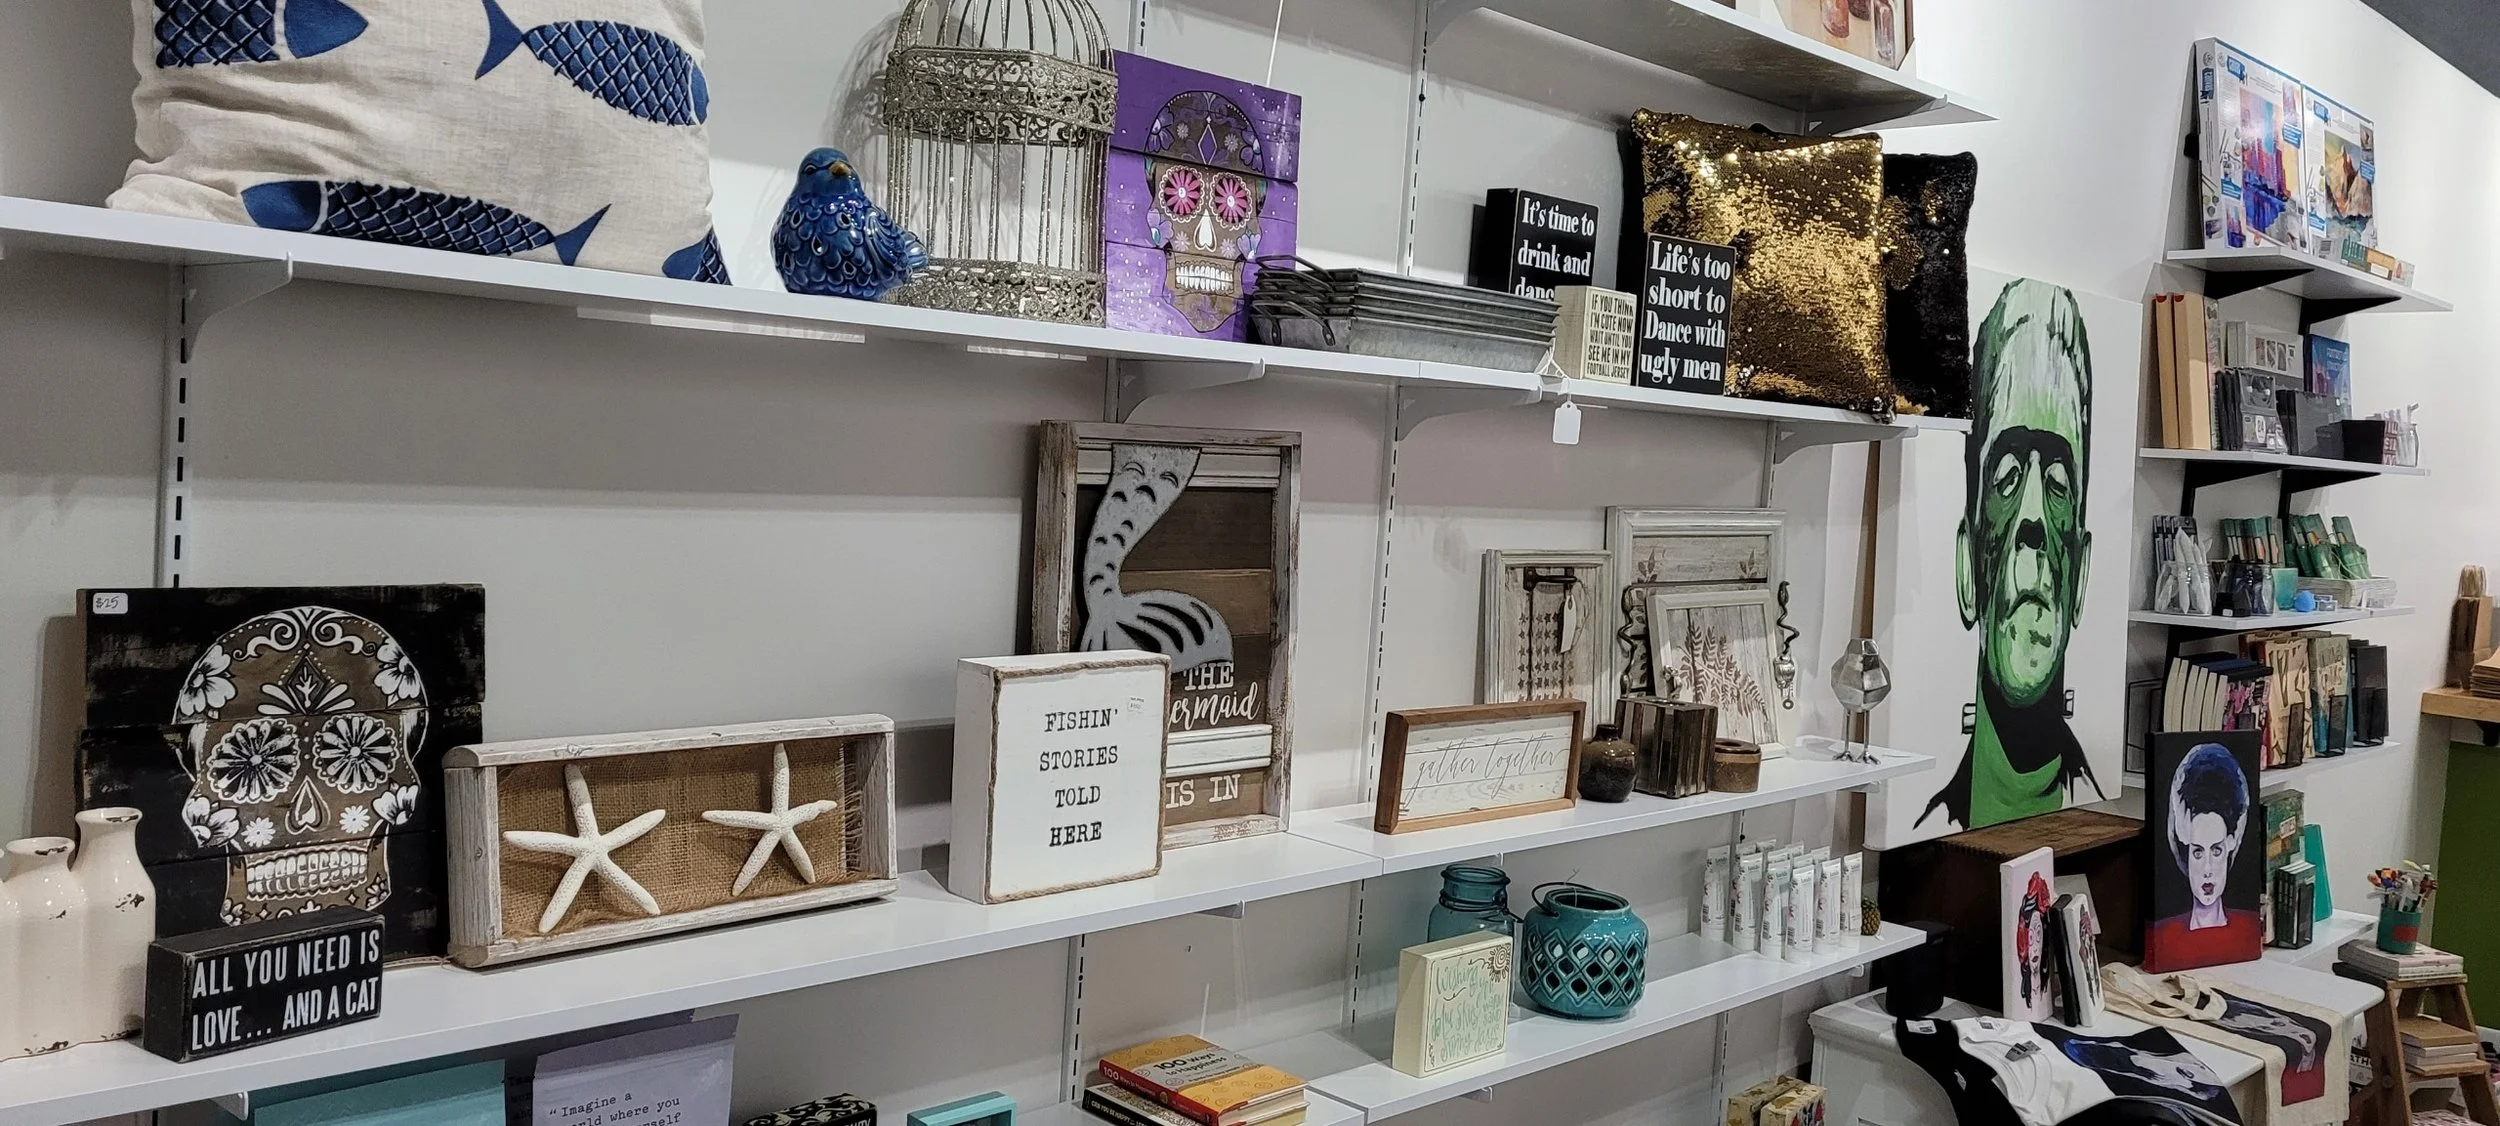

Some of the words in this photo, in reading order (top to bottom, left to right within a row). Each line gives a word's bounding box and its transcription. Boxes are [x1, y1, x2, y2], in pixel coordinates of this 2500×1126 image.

[1522, 197, 1546, 227] It's
[1548, 204, 1579, 233] time
[1581, 212, 1595, 236] to
[1518, 239, 1560, 272] drink
[1563, 251, 1592, 277] and
[1650, 240, 1701, 276] Life's
[1704, 252, 1731, 280] too
[1515, 276, 1555, 299] danc
[1648, 276, 1702, 311] short
[1706, 286, 1726, 314] to
[1591, 293, 1598, 310] IF
[1600, 295, 1613, 313] YOU
[1614, 297, 1634, 317] THINK
[1601, 313, 1616, 331] CUTE
[1617, 317, 1633, 333] NOW
[1643, 310, 1692, 344] Dance
[1695, 318, 1726, 348] with
[1590, 329, 1604, 345] WAIT
[1604, 331, 1620, 347] UNTIL
[1622, 334, 1632, 349] YOU
[1588, 344, 1600, 362] SEE
[1601, 346, 1611, 363] ME
[1612, 347, 1620, 364] IN
[1621, 349, 1631, 367] MY
[1641, 347, 1680, 385] ugly
[1682, 357, 1721, 382] men
[1587, 362, 1610, 377] FOOTBALL
[1611, 365, 1630, 379] JERSEY
[1183, 661, 1235, 691] THE
[1168, 681, 1262, 731] ermaid
[1044, 707, 1118, 733] FISHIN'
[1039, 745, 1118, 772] STORIES
[1403, 737, 1480, 809] gather
[1484, 731, 1568, 800] together
[1054, 785, 1101, 808] TOLD
[1165, 778, 1195, 809] IS
[1209, 773, 1241, 803] IN
[1049, 821, 1102, 847] HERE
[192, 957, 234, 999] ALL
[244, 946, 288, 988] YOU
[297, 934, 351, 978] NEED
[360, 929, 380, 965] IS
[282, 988, 323, 1031] AND
[327, 985, 340, 1021] A
[345, 976, 379, 1016] CAT
[1103, 1066, 1119, 1080] 100
[1153, 1058, 1187, 1070] 100
[1186, 1052, 1216, 1063] Ways
[609, 1105, 649, 1122] where
[656, 1097, 681, 1113] you
[624, 1092, 633, 1102] a
